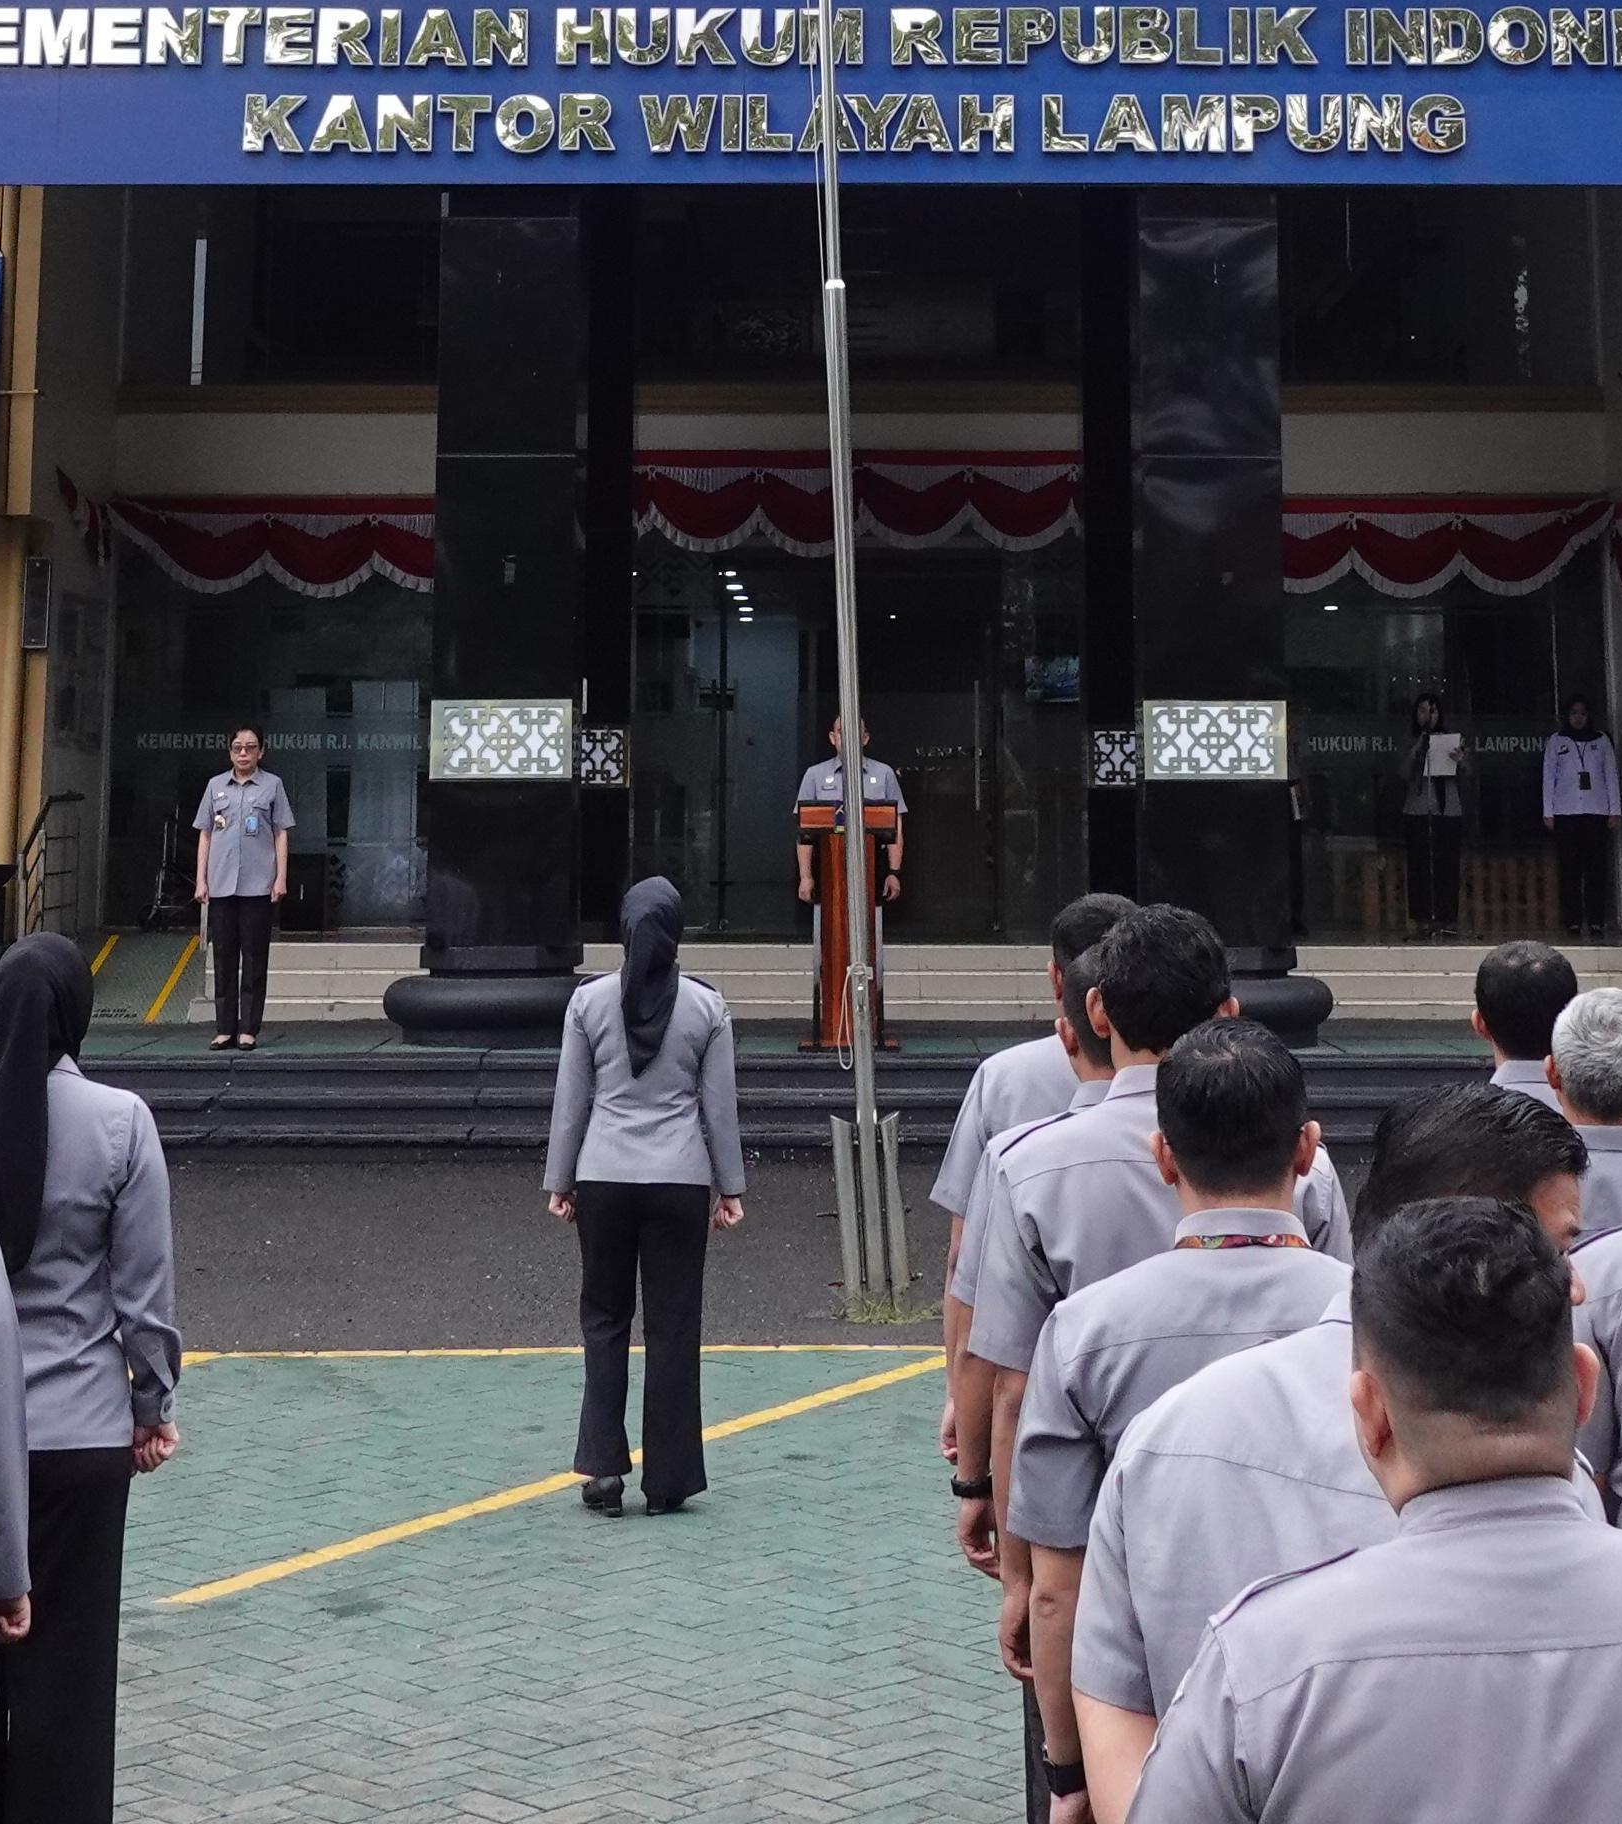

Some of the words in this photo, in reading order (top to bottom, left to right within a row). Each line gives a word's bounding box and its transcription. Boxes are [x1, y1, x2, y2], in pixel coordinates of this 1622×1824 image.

[554, 6, 865, 68] HUKUM
[890, 4, 1320, 67] REPUBLIK
[241, 92, 617, 154] KANTOR
[637, 93, 1016, 154] WILAYAH
[1041, 92, 1468, 154] LAMPUNG
[136, 733, 230, 750] KEMENTER
[326, 733, 352, 750] R.I.
[358, 733, 422, 750] KANWIL
[1475, 736, 1545, 752] LAMPUN
